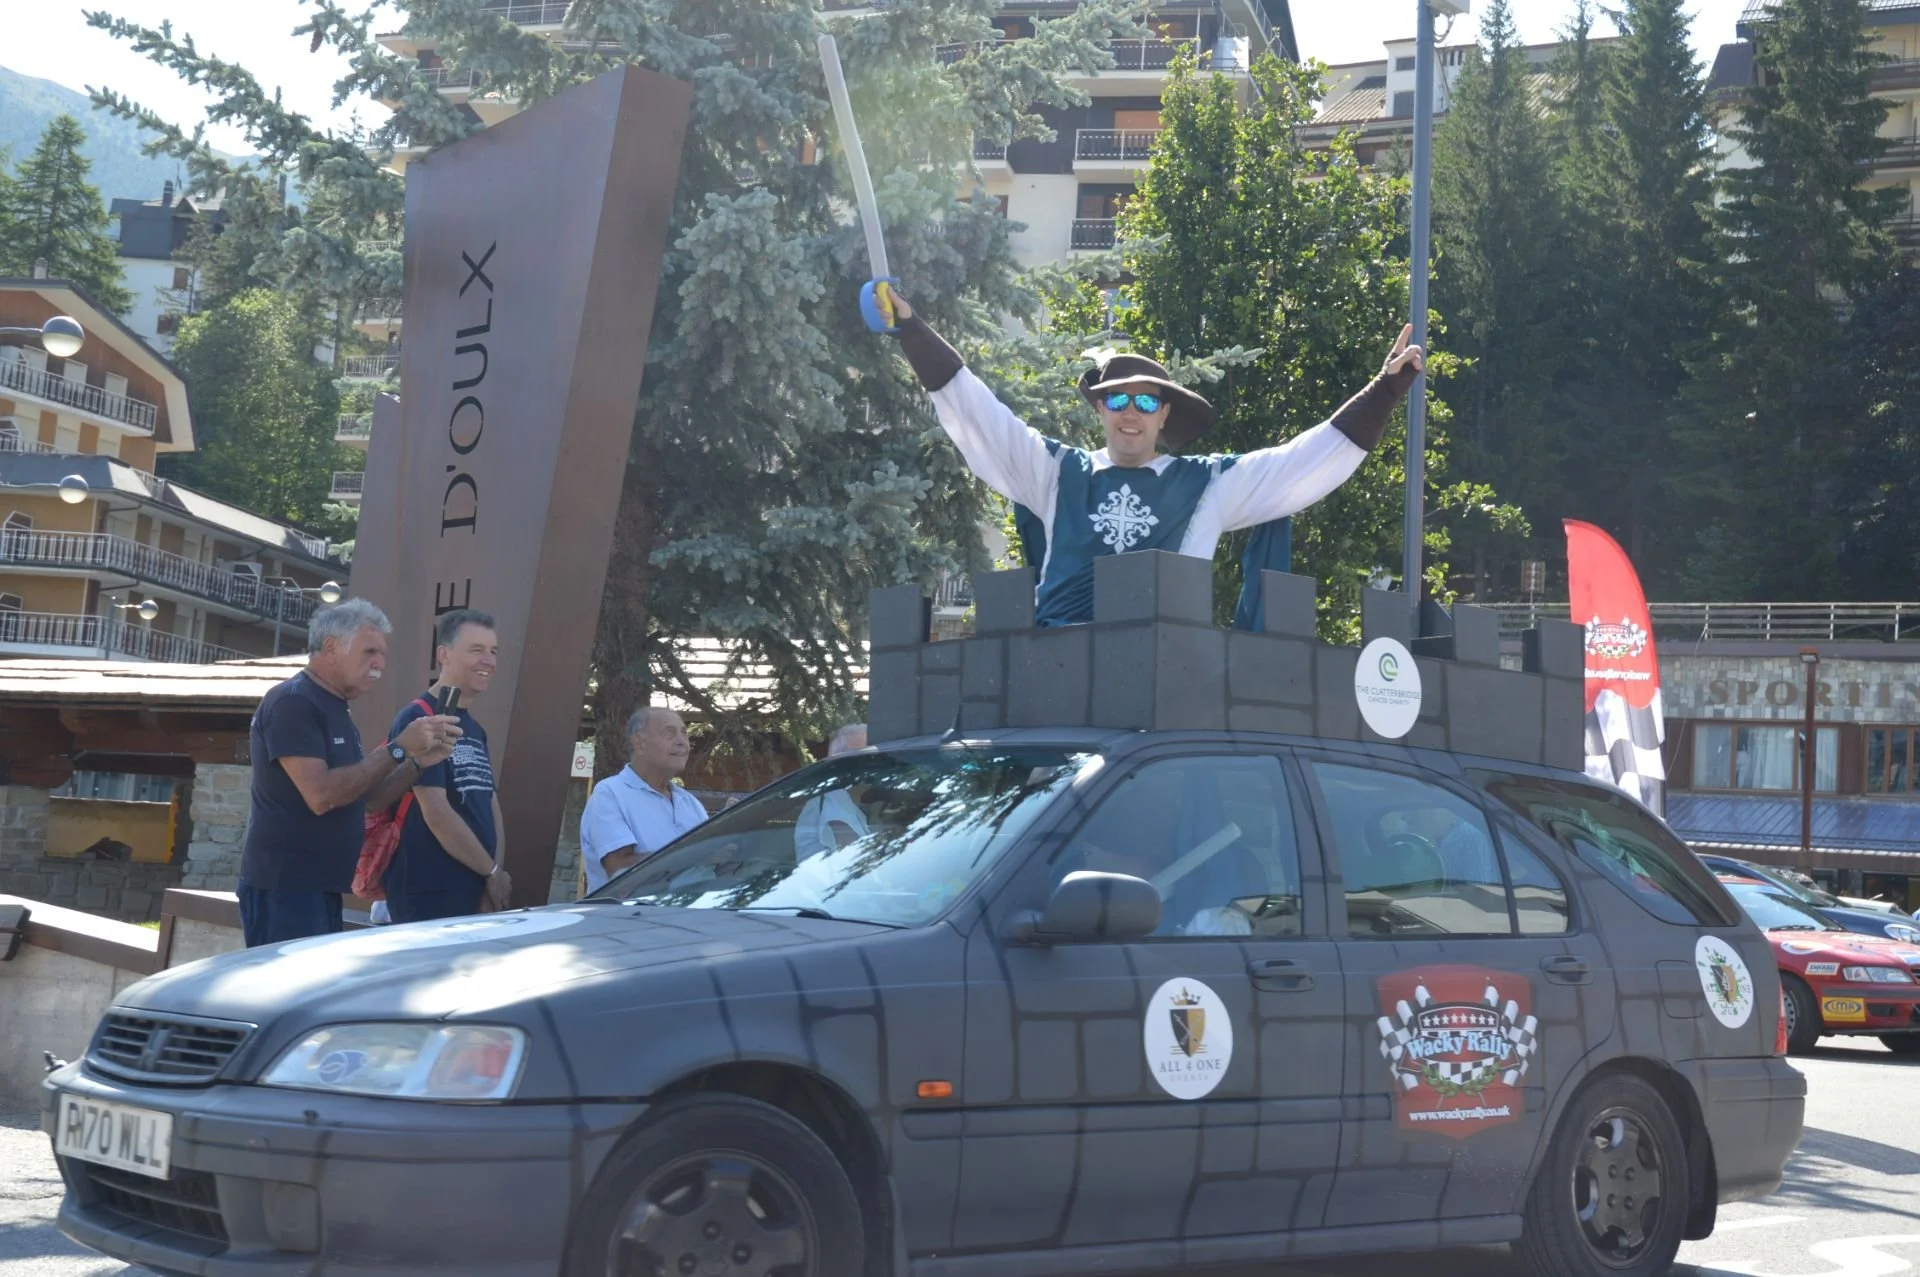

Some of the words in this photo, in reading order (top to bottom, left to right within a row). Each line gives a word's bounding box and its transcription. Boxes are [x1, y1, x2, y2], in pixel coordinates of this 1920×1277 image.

[440, 240, 497, 538] D'OULX
[1406, 1031, 1464, 1061] Wacky
[1466, 1030, 1512, 1061] Rally
[1160, 1060, 1182, 1073] ALL
[1186, 1060, 1193, 1072] 4
[1196, 1059, 1222, 1071] ONE
[1408, 1105, 1511, 1121] www.wackyrally.co.uk
[65, 1102, 113, 1155] R170
[118, 1111, 163, 1169] WLL
